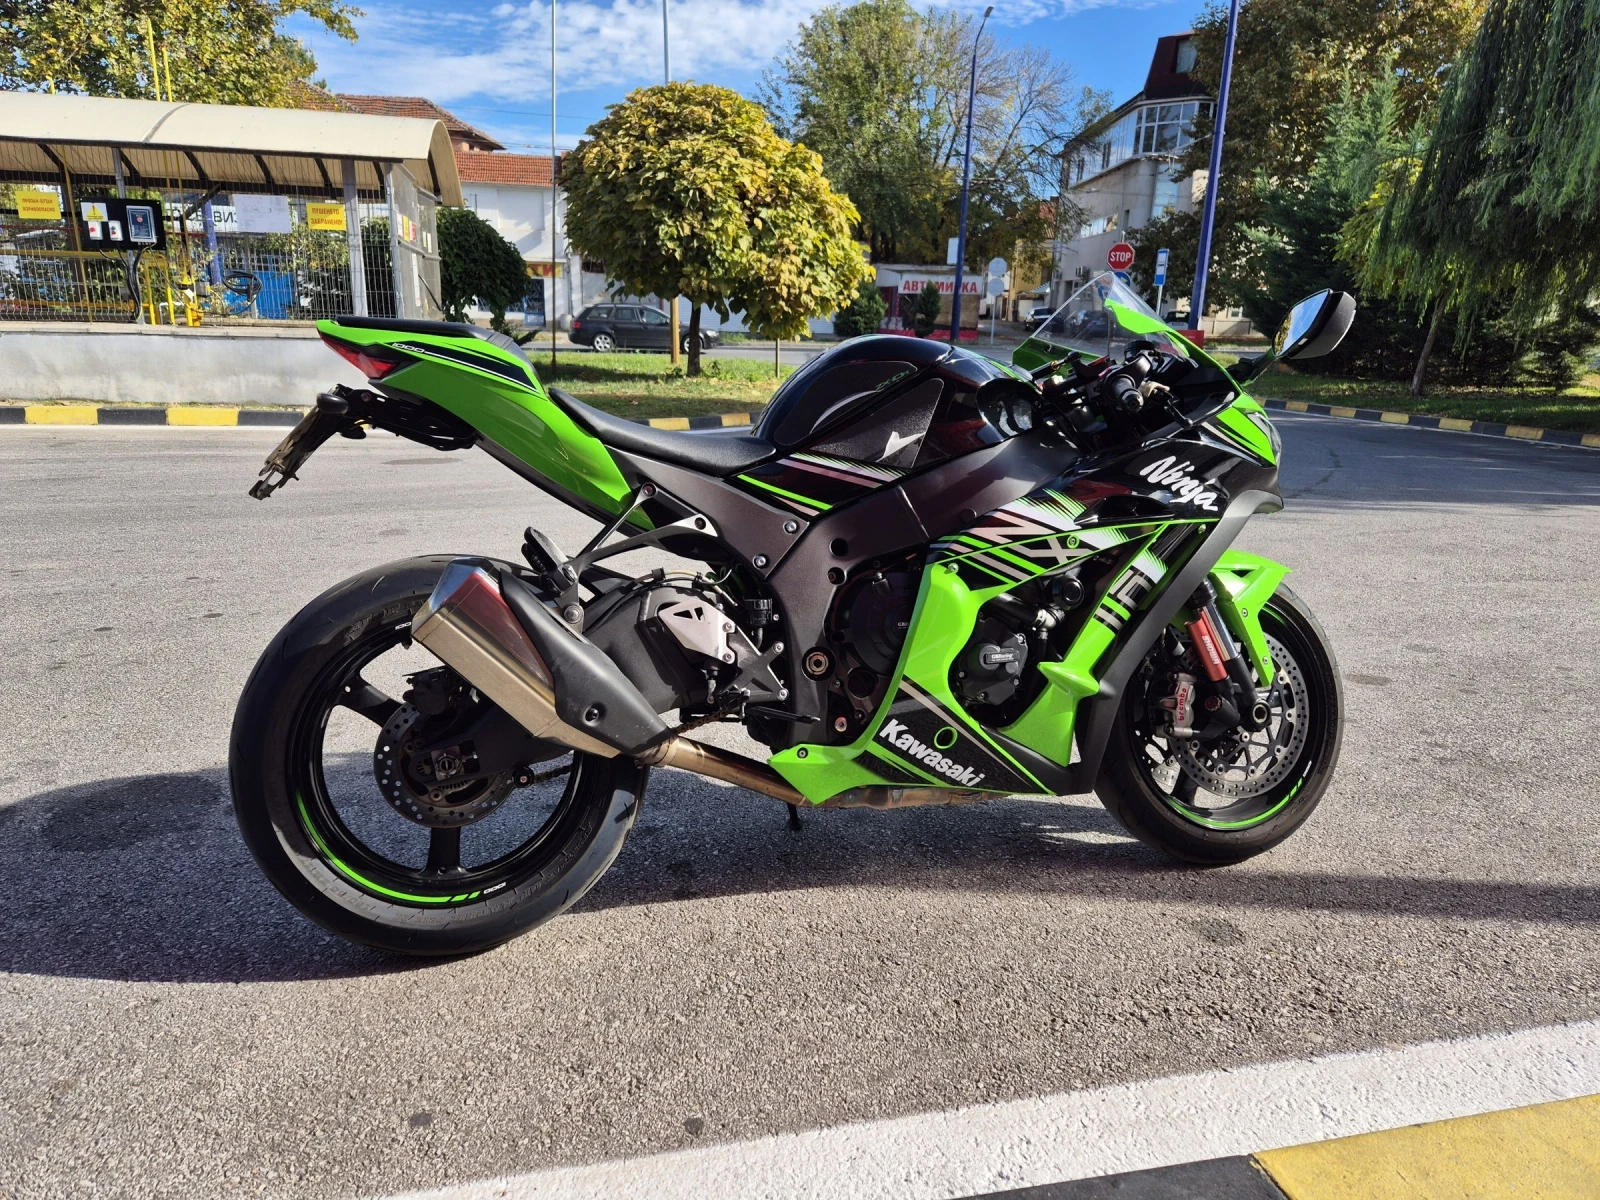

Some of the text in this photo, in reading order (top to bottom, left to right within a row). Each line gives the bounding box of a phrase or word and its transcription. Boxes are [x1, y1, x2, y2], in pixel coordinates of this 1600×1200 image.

[1110, 252, 1131, 262] STOP
[903, 280, 978, 293] АВТМИКА
[391, 342, 425, 353] 1000
[1140, 455, 1219, 512] Ninja
[1177, 687, 1188, 723] brembo
[878, 718, 986, 788] Kawasaki
